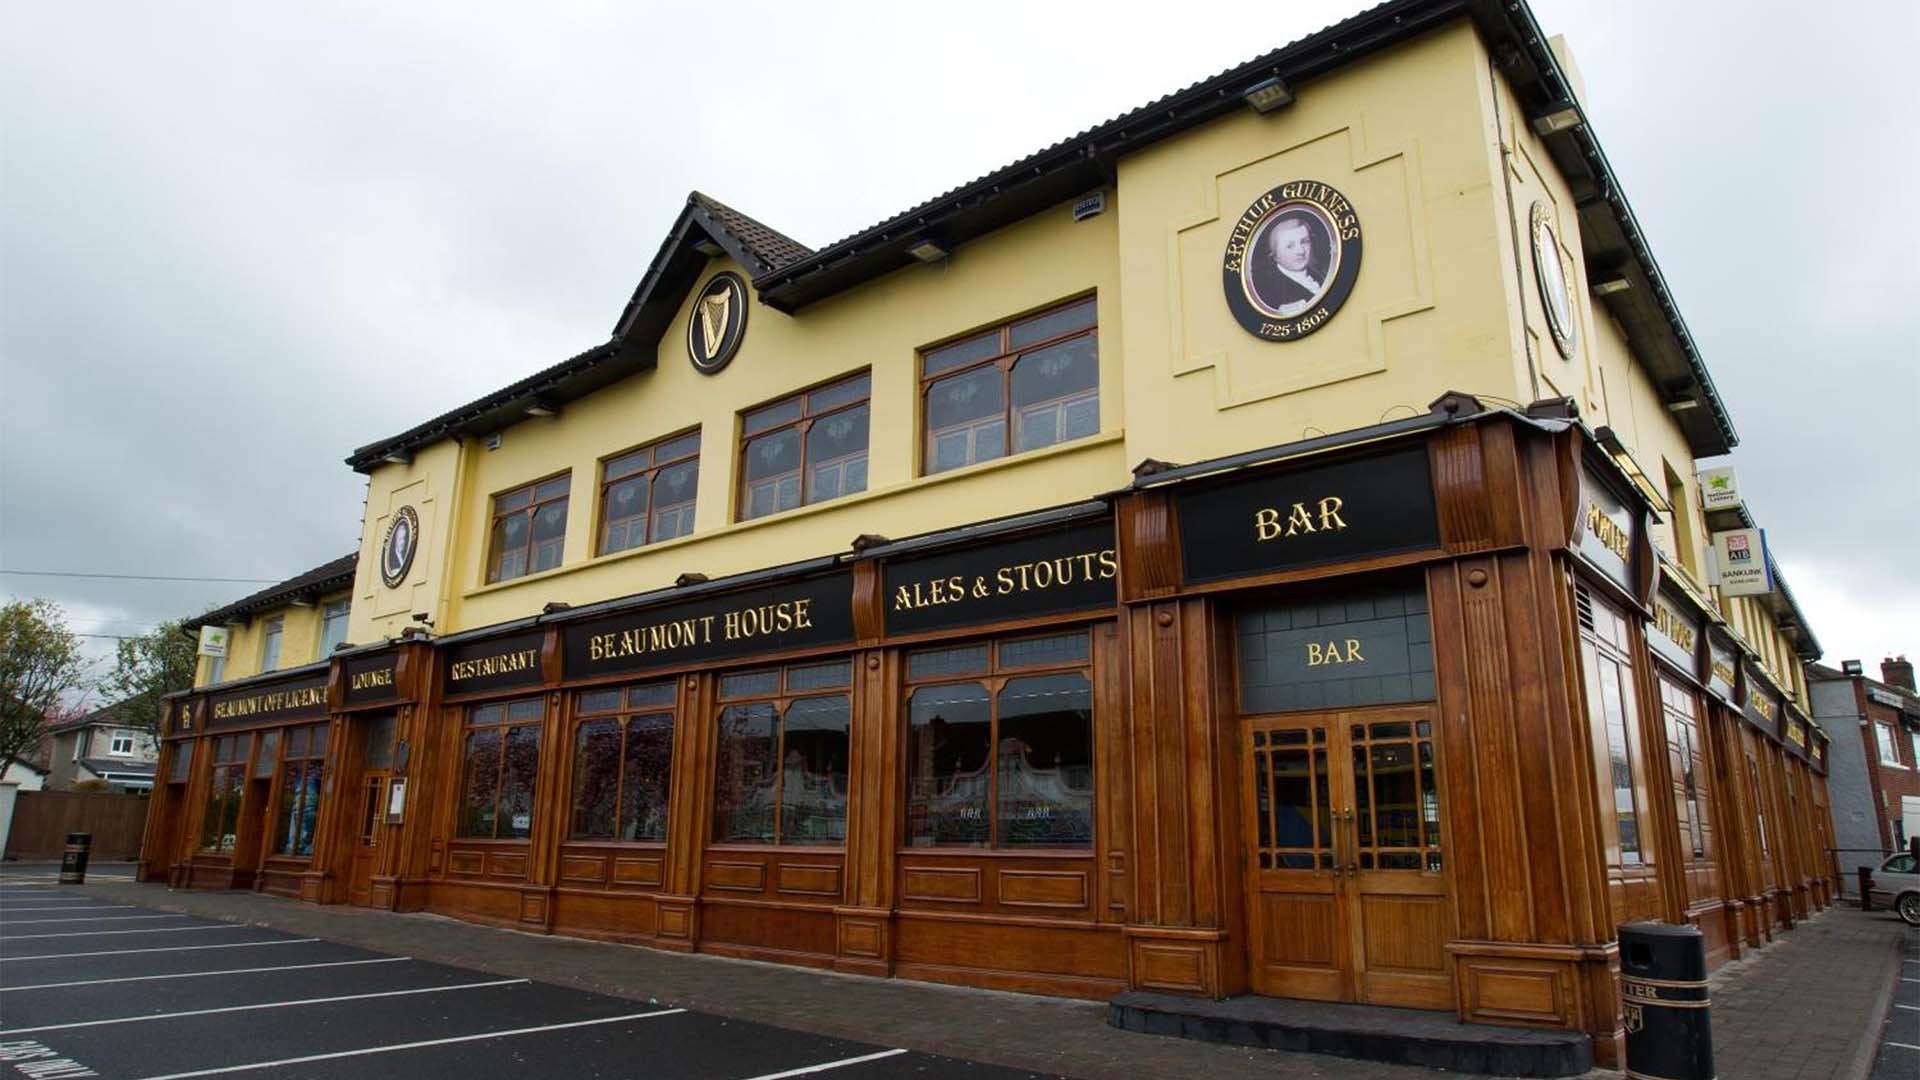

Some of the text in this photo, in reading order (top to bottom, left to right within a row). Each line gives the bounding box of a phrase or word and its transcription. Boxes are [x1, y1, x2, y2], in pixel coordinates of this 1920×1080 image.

[1226, 182, 1360, 273] ARTHUR GUINNESS
[1260, 307, 1329, 337] 1725-1803
[1255, 496, 1347, 542] BAR
[1730, 551, 1750, 560] AIB
[894, 550, 1118, 611] ALES & STOUTS
[590, 598, 813, 661] BEAUMONT HOUSE
[451, 649, 537, 681] RESTAURANT
[1305, 638, 1365, 666] BAR
[352, 668, 393, 690] LOUNGE
[214, 696, 262, 720] BEAUMONT
[264, 691, 284, 712] OFF
